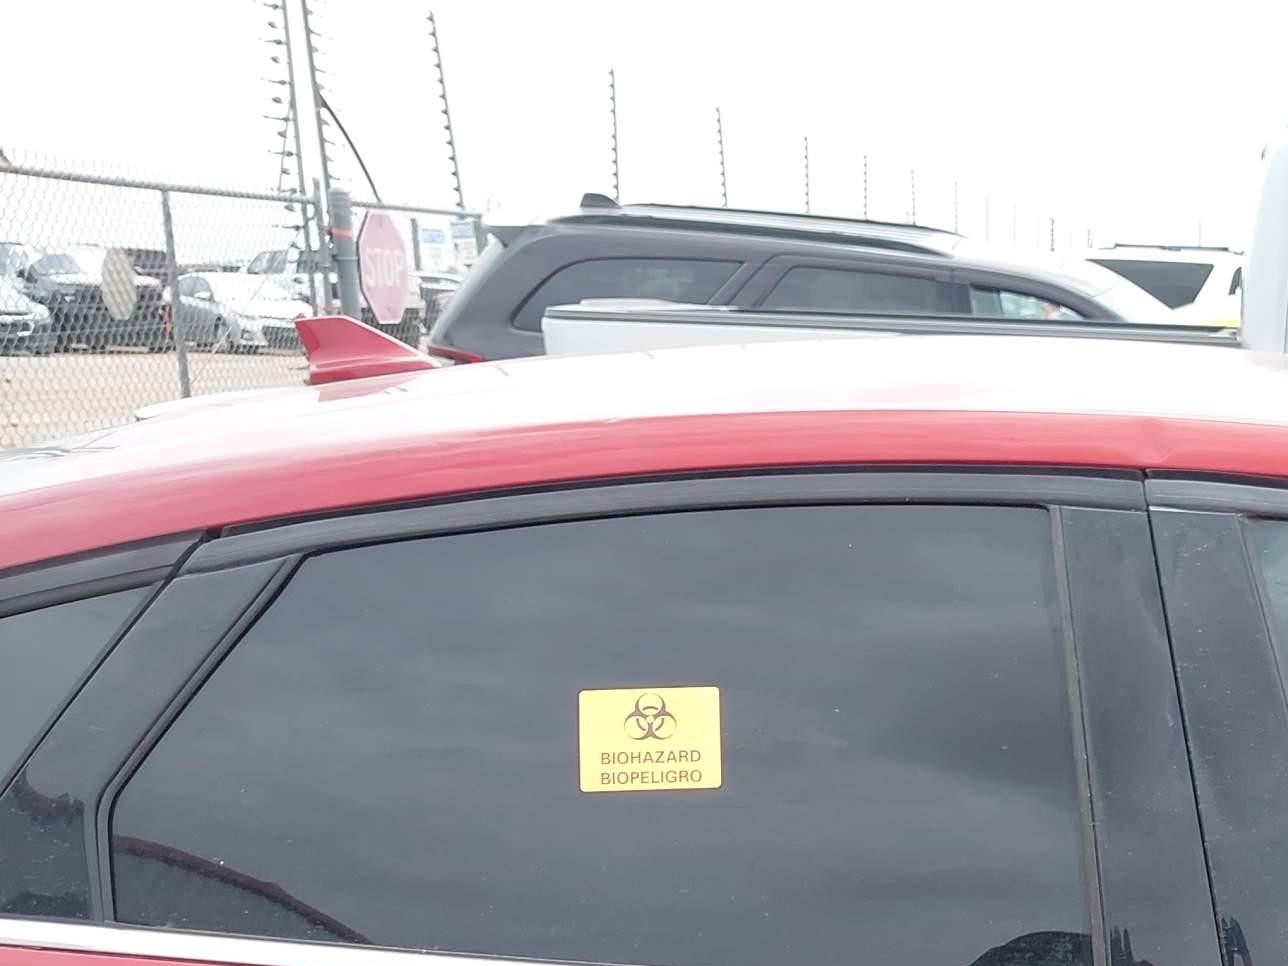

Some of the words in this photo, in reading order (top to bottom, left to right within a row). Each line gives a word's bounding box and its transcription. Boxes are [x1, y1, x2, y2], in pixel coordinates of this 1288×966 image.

[365, 248, 404, 288] STOP
[600, 749, 702, 765] BIOHAZARD
[600, 769, 703, 785] BIOPELIGRO
